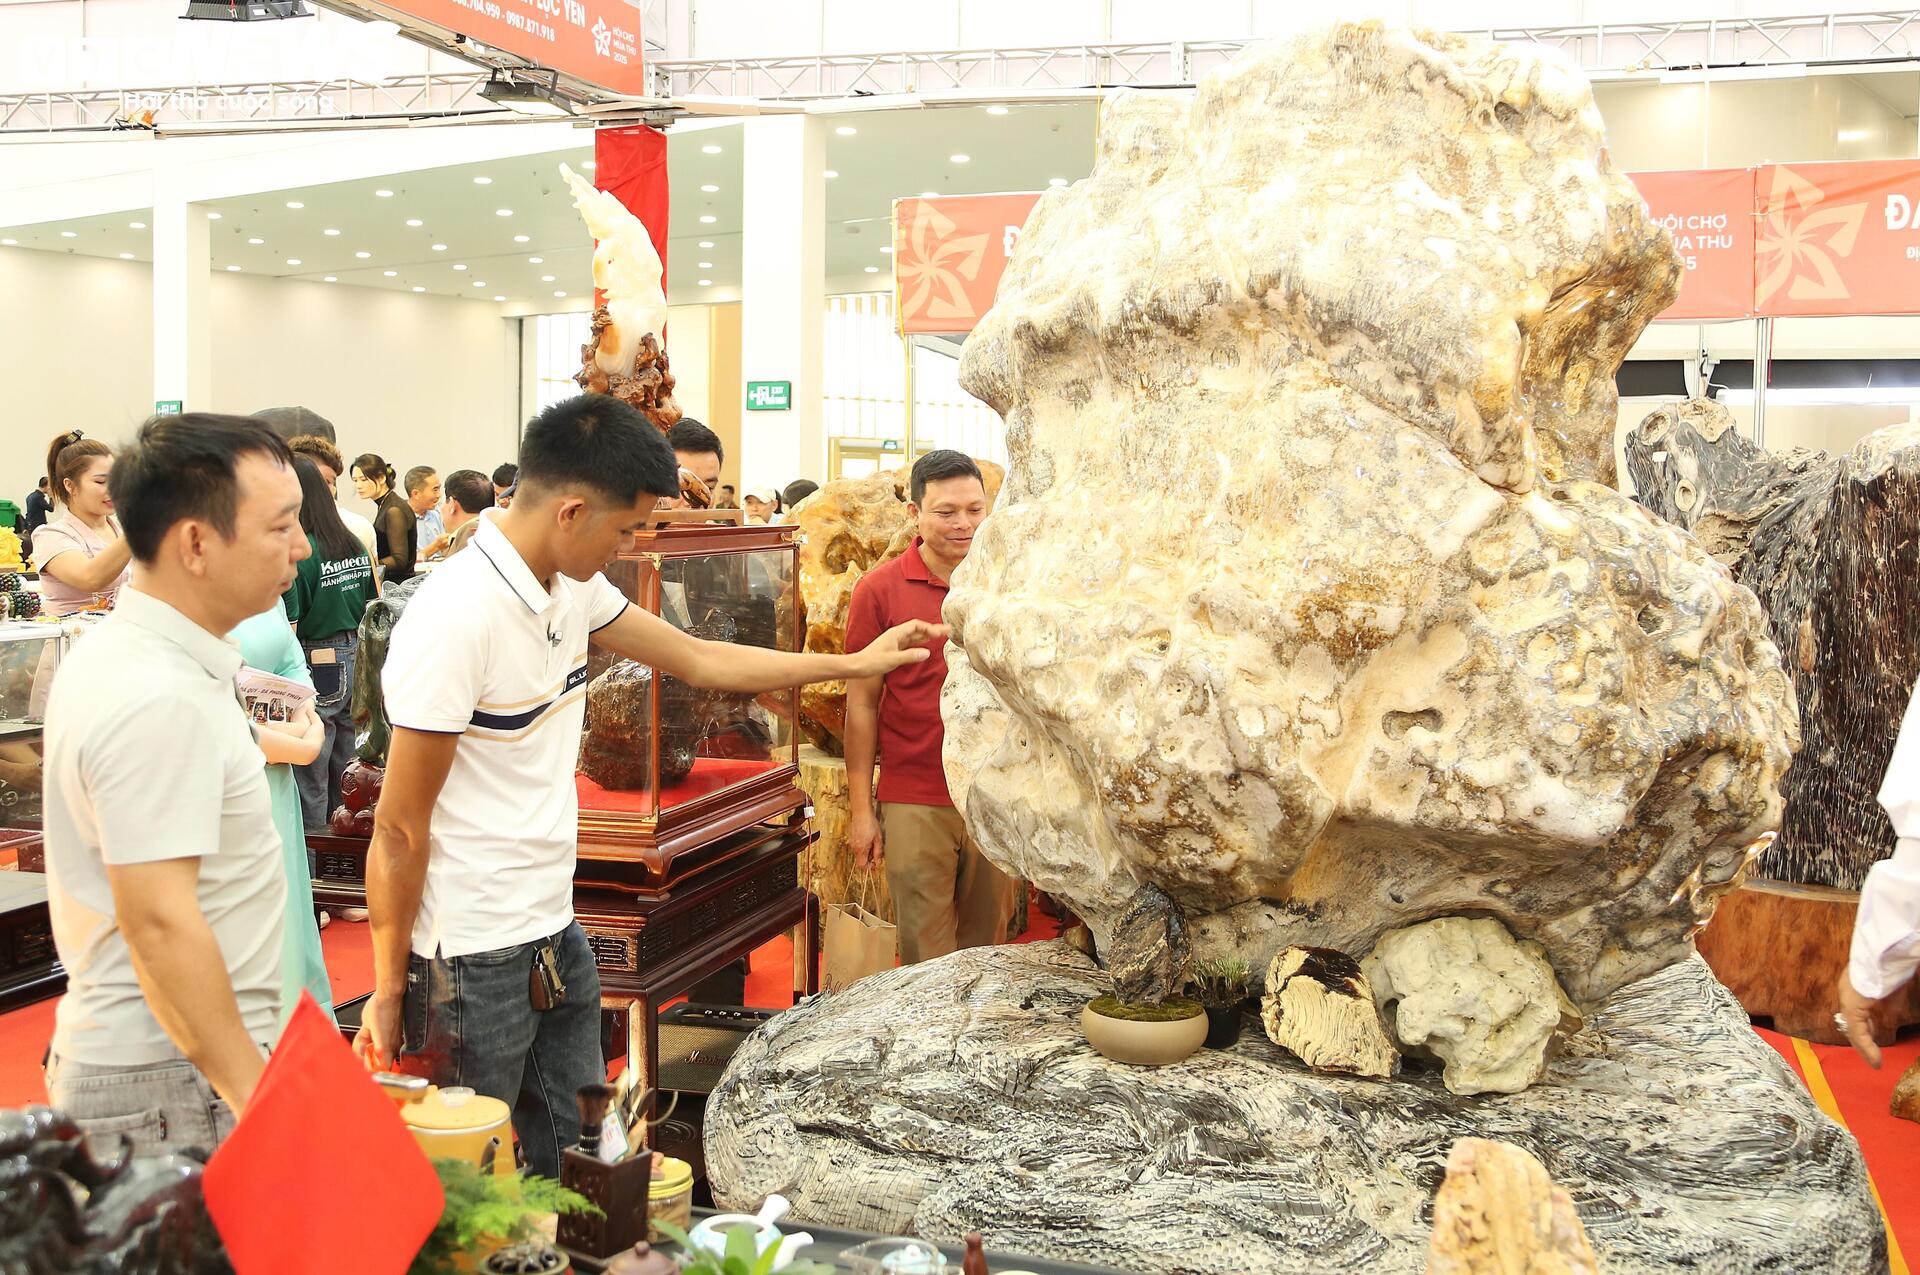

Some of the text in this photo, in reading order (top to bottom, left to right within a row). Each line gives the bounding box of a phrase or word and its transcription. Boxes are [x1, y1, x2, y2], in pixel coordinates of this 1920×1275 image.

[506, 10, 556, 41] 0987.871.918
[1687, 214, 1727, 232] CHỢ
[1696, 235, 1732, 249] THU
